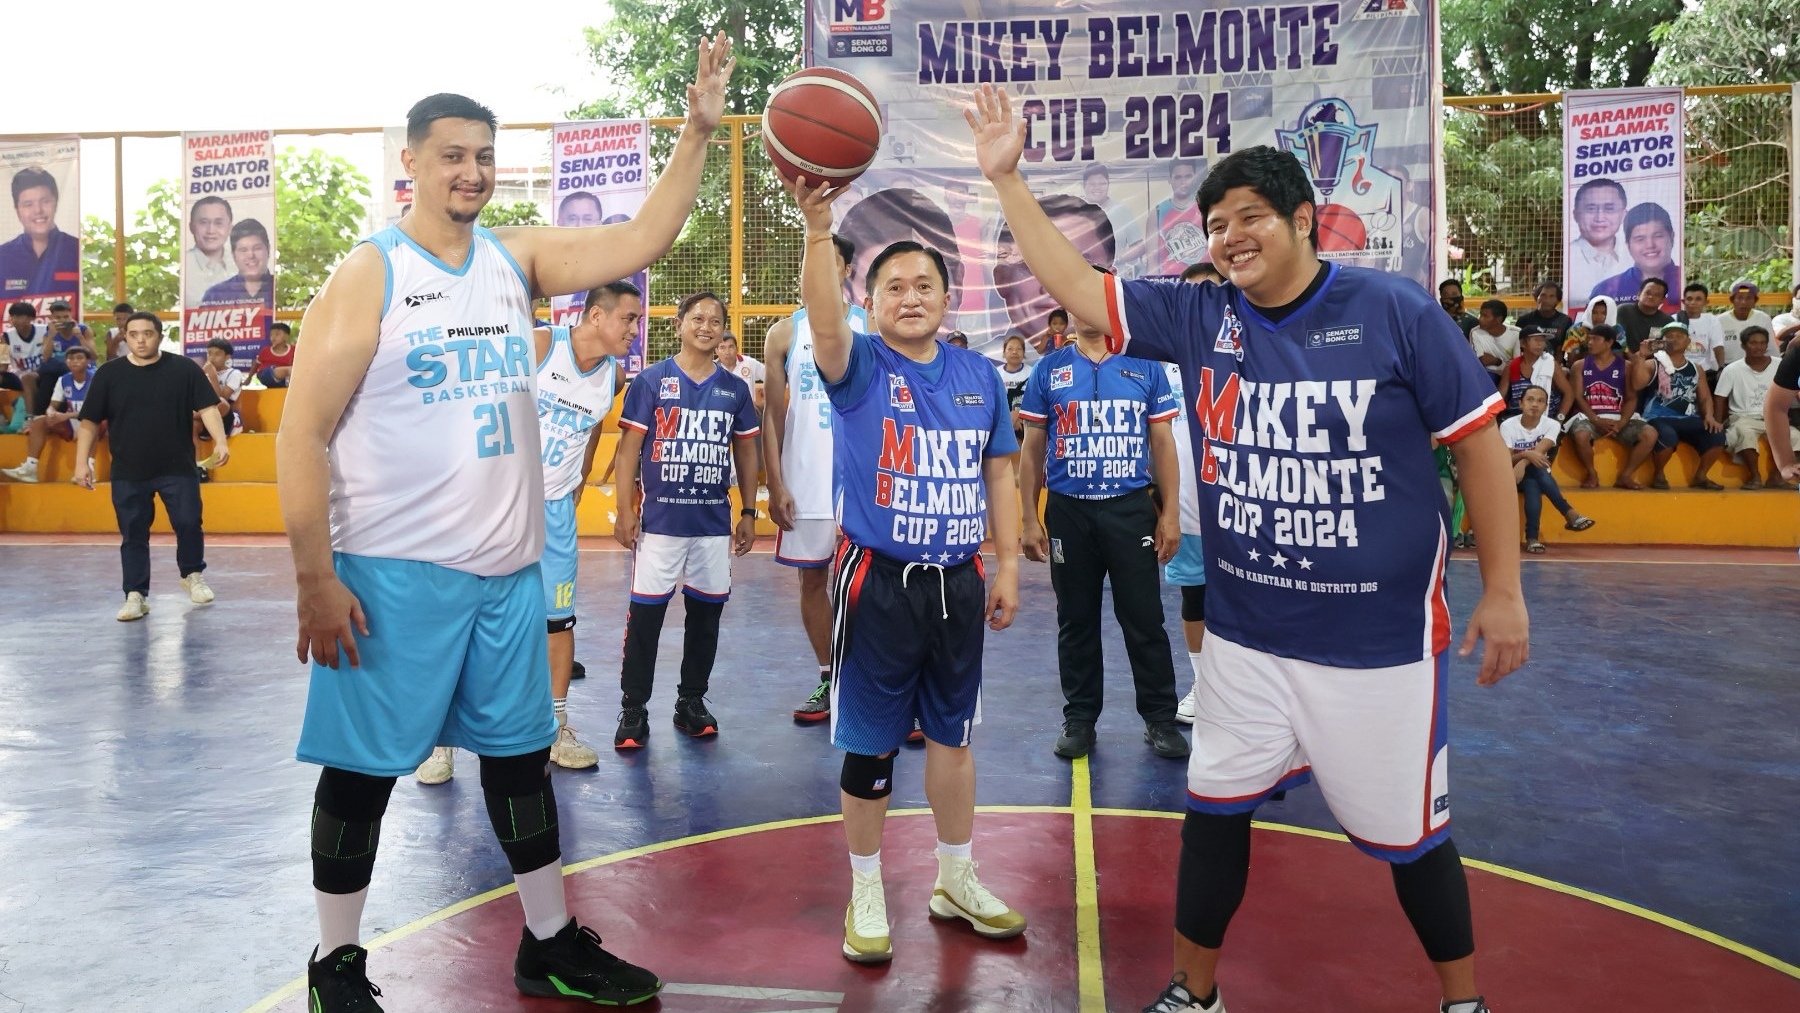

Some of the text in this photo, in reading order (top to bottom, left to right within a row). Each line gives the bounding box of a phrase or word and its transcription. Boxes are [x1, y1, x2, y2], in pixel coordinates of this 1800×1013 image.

[917, 2, 1340, 85] MIKEY BELMONTE
[1572, 102, 1675, 127] MARAMING
[556, 123, 641, 143] MARAMING
[1021, 91, 1232, 163] CUP 2024
[1580, 118, 1669, 140] SALAMAT,
[188, 130, 269, 149] MARAMING
[563, 137, 637, 156] SALAMAT,
[1576, 135, 1674, 160] SENATOR
[195, 144, 265, 161] SALAMAT,
[560, 153, 641, 174] SENATOR
[192, 159, 269, 178] SENATOR
[1574, 152, 1675, 178] BONG GO!
[190, 175, 270, 194] BONG GO!
[558, 169, 642, 191] BONG GO!
[188, 307, 260, 331] MIKEY
[186, 327, 261, 343] BELMONTE
[404, 325, 444, 346] THE
[1325, 328, 1360, 337] SENATOR
[405, 336, 531, 389] STAR
[1612, 370, 1619, 378] 2
[422, 381, 530, 405] BASKETBALL
[557, 397, 593, 416] PHILIPPINE
[1053, 400, 1147, 436] MIKEY
[1196, 367, 1377, 453] MIKEY
[473, 401, 515, 459] 21
[654, 406, 734, 443] MIKEY
[650, 440, 730, 466] BELMONTE
[1056, 436, 1144, 459] BELMONTE
[661, 464, 723, 484] CUP 2024
[1067, 460, 1136, 478] CUP 2024
[1201, 437, 1385, 505] BELMONTE
[892, 514, 939, 545] CUP
[1218, 493, 1359, 547] CUP 2024
[1217, 557, 1378, 593] LAKAS NG KABATAAN NG DISTRITO DOS
